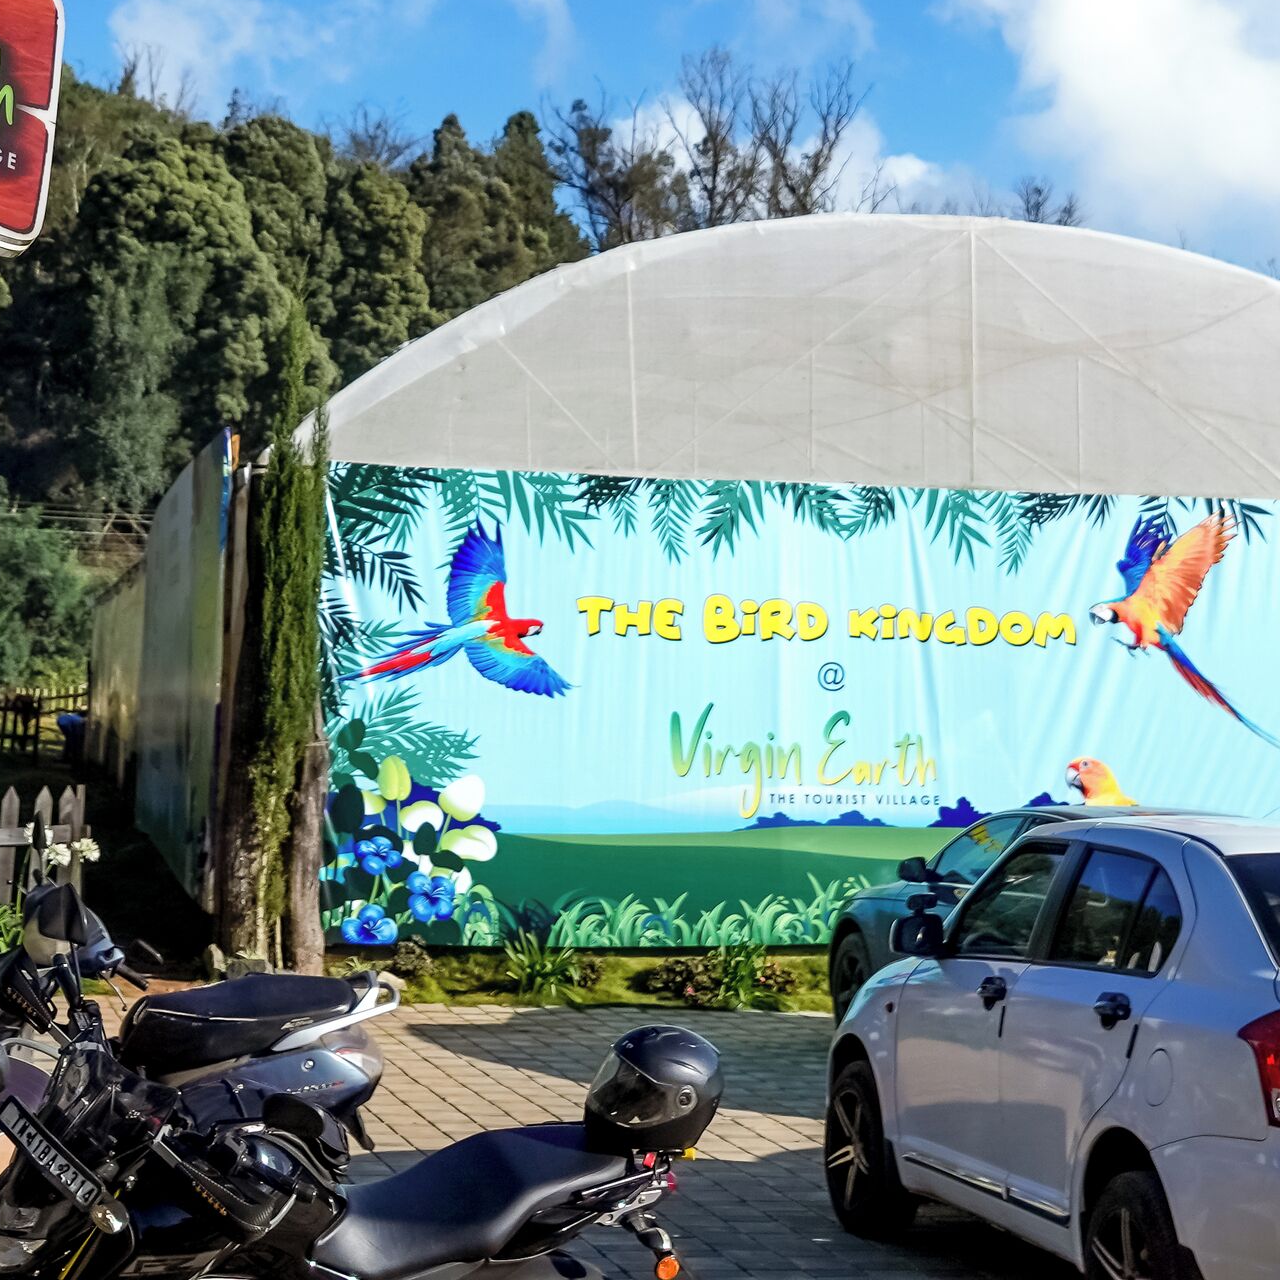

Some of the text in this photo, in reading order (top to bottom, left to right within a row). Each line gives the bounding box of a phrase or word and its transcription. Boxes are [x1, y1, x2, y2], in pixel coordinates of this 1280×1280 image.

[576, 596, 684, 641] THE
[817, 662, 846, 691] @
[669, 701, 937, 819] Virgin Earth
[769, 793, 940, 806] THE TOURIST VILLAGE
